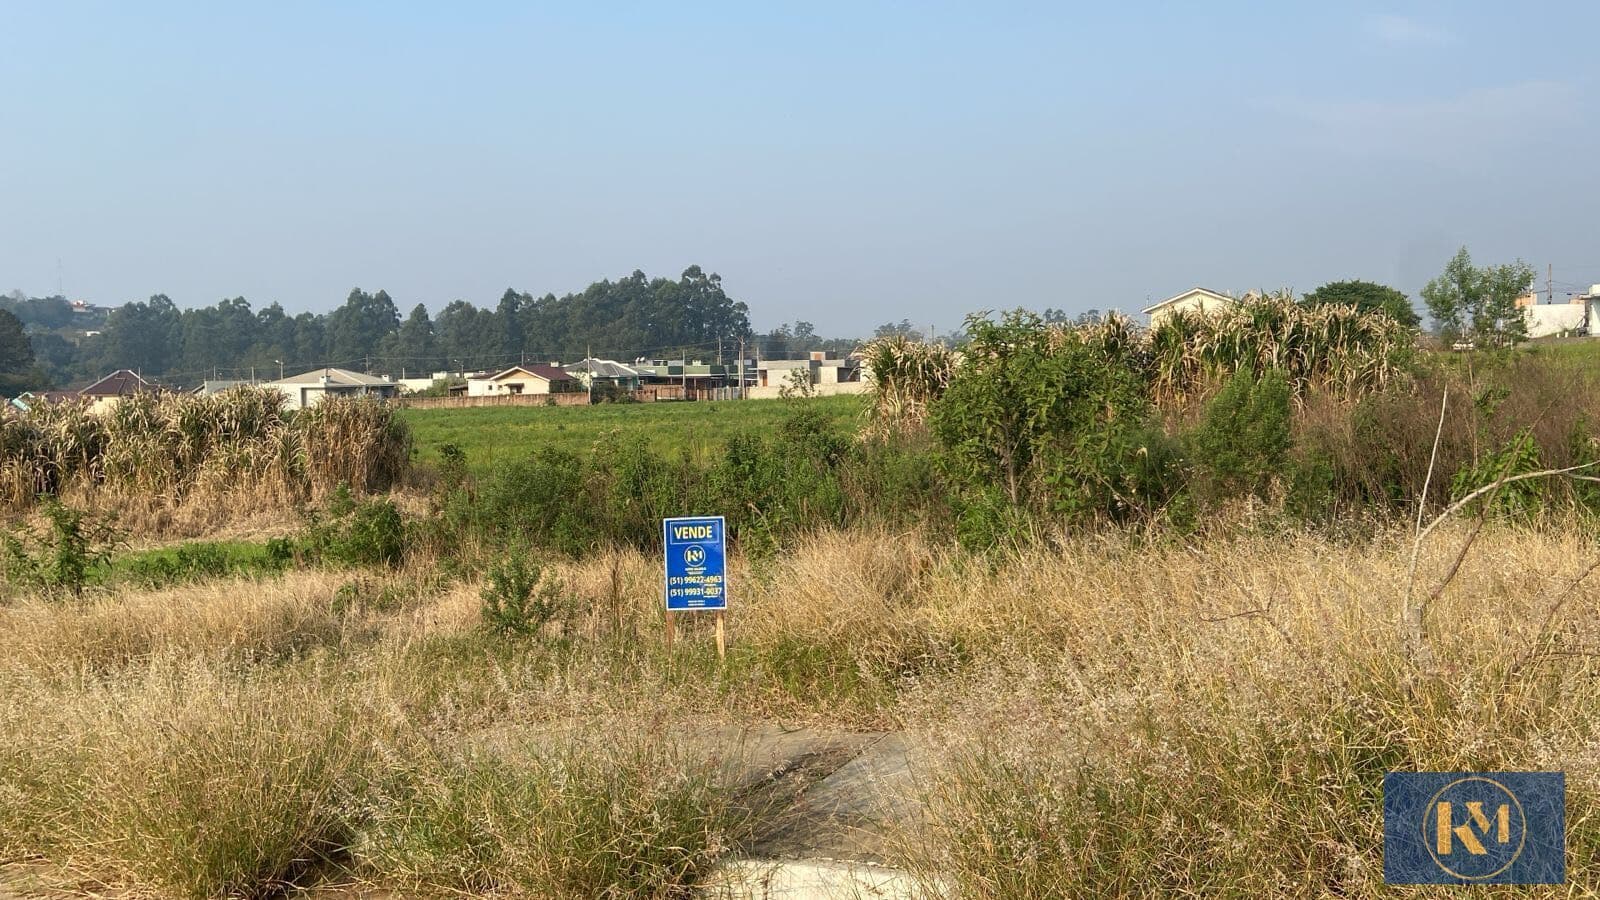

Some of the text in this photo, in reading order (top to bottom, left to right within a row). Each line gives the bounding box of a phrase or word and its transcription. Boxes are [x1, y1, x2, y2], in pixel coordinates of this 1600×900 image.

[674, 526, 713, 539] VENDE
[669, 577, 684, 586] (51)
[670, 588, 684, 597] (51)
